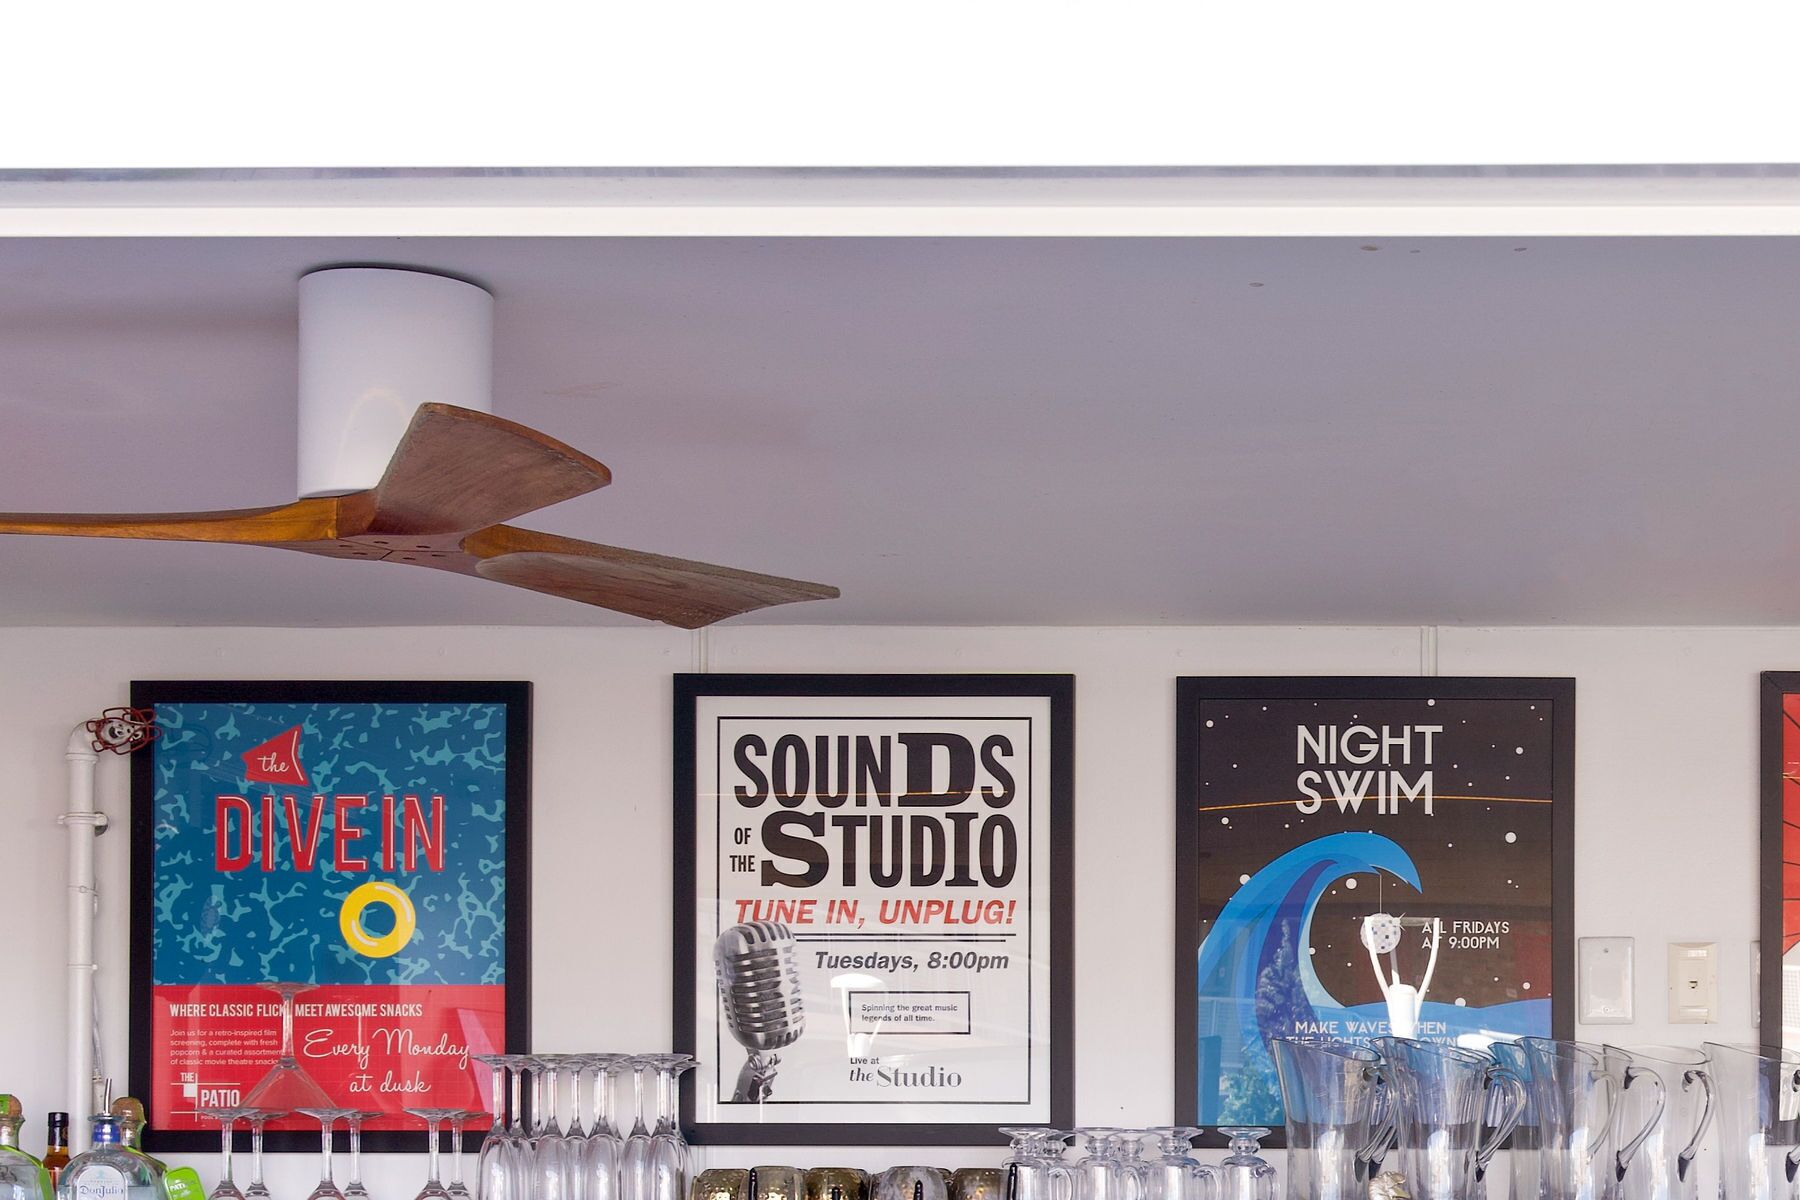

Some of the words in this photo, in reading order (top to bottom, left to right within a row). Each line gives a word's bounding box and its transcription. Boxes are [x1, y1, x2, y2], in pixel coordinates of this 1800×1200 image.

[1297, 725, 1443, 765] NIGHT
[256, 754, 290, 774] the
[733, 732, 1016, 809] SOUNDS
[1296, 770, 1433, 815] SWIM
[215, 795, 368, 872] DIVE
[382, 795, 445, 872] IN
[735, 827, 752, 845] OF
[730, 855, 756, 872] THE
[761, 810, 1017, 889] STUDIO
[735, 899, 816, 925] TUNE
[826, 899, 866, 930] IN,
[879, 899, 1016, 926] UNPLUG!
[1453, 921, 1510, 934] FRIDAYS
[1449, 937, 1500, 949] 9:00PM
[815, 950, 919, 973] Tuesdays,
[927, 951, 1009, 974] 8:00pm
[170, 1004, 207, 1017] WHERE
[209, 1004, 254, 1017] CLASSIC
[295, 1004, 324, 1017] MEET
[325, 1004, 378, 1017] AWESOME
[380, 1004, 423, 1017] SNACKS
[862, 1004, 895, 1013] Spinning
[912, 1004, 932, 1013] great
[862, 1014, 892, 1023] legends
[1295, 1021, 1339, 1034] MAKE
[208, 1039, 242, 1047] complete
[214, 1030, 262, 1038] retro-inspired
[170, 1049, 200, 1057] popcorn
[215, 1048, 242, 1056] curated
[303, 1028, 370, 1069] Every
[372, 1028, 471, 1069] Monday
[180, 1072, 194, 1082] THE
[349, 1071, 373, 1093] at
[379, 1071, 432, 1094] dusk
[849, 1067, 874, 1081] the
[877, 1066, 962, 1087] Studio
[201, 1090, 240, 1107] PATIO
